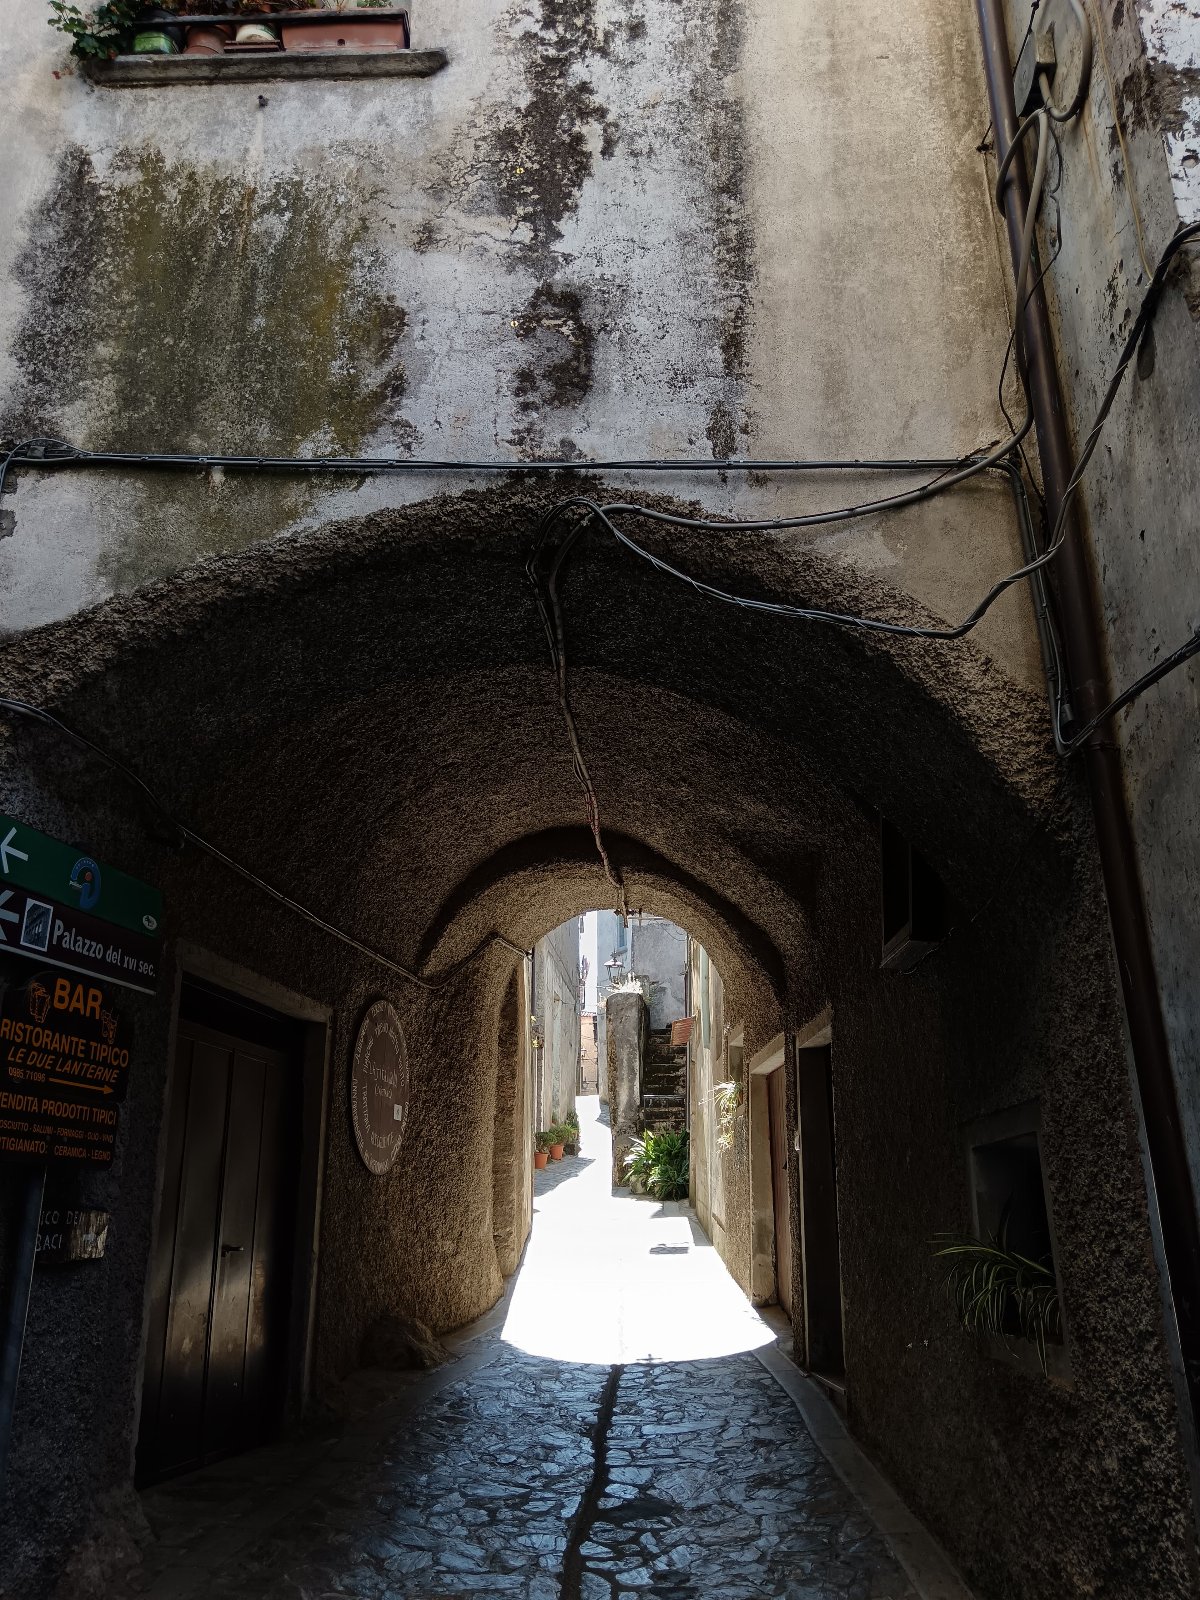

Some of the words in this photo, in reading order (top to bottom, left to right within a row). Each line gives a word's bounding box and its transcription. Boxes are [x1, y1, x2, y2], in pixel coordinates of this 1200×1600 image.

[53, 919, 104, 960] Palazzo
[106, 944, 121, 966] del
[138, 960, 156, 977] sec.
[53, 977, 103, 1020] BAR
[0, 1018, 87, 1058] RISTORANTE
[89, 1041, 129, 1068] TIPICO
[7, 1045, 27, 1063] LE
[26, 1050, 56, 1069] DUE
[56, 1057, 120, 1083] LANTERNE
[41, 1098, 90, 1121] PRODOTTI
[92, 1107, 117, 1126] TIPICI
[54, 1144, 87, 1158] CERAMICA
[91, 1148, 111, 1161] LEGNO
[40, 1210, 60, 1226] ICO
